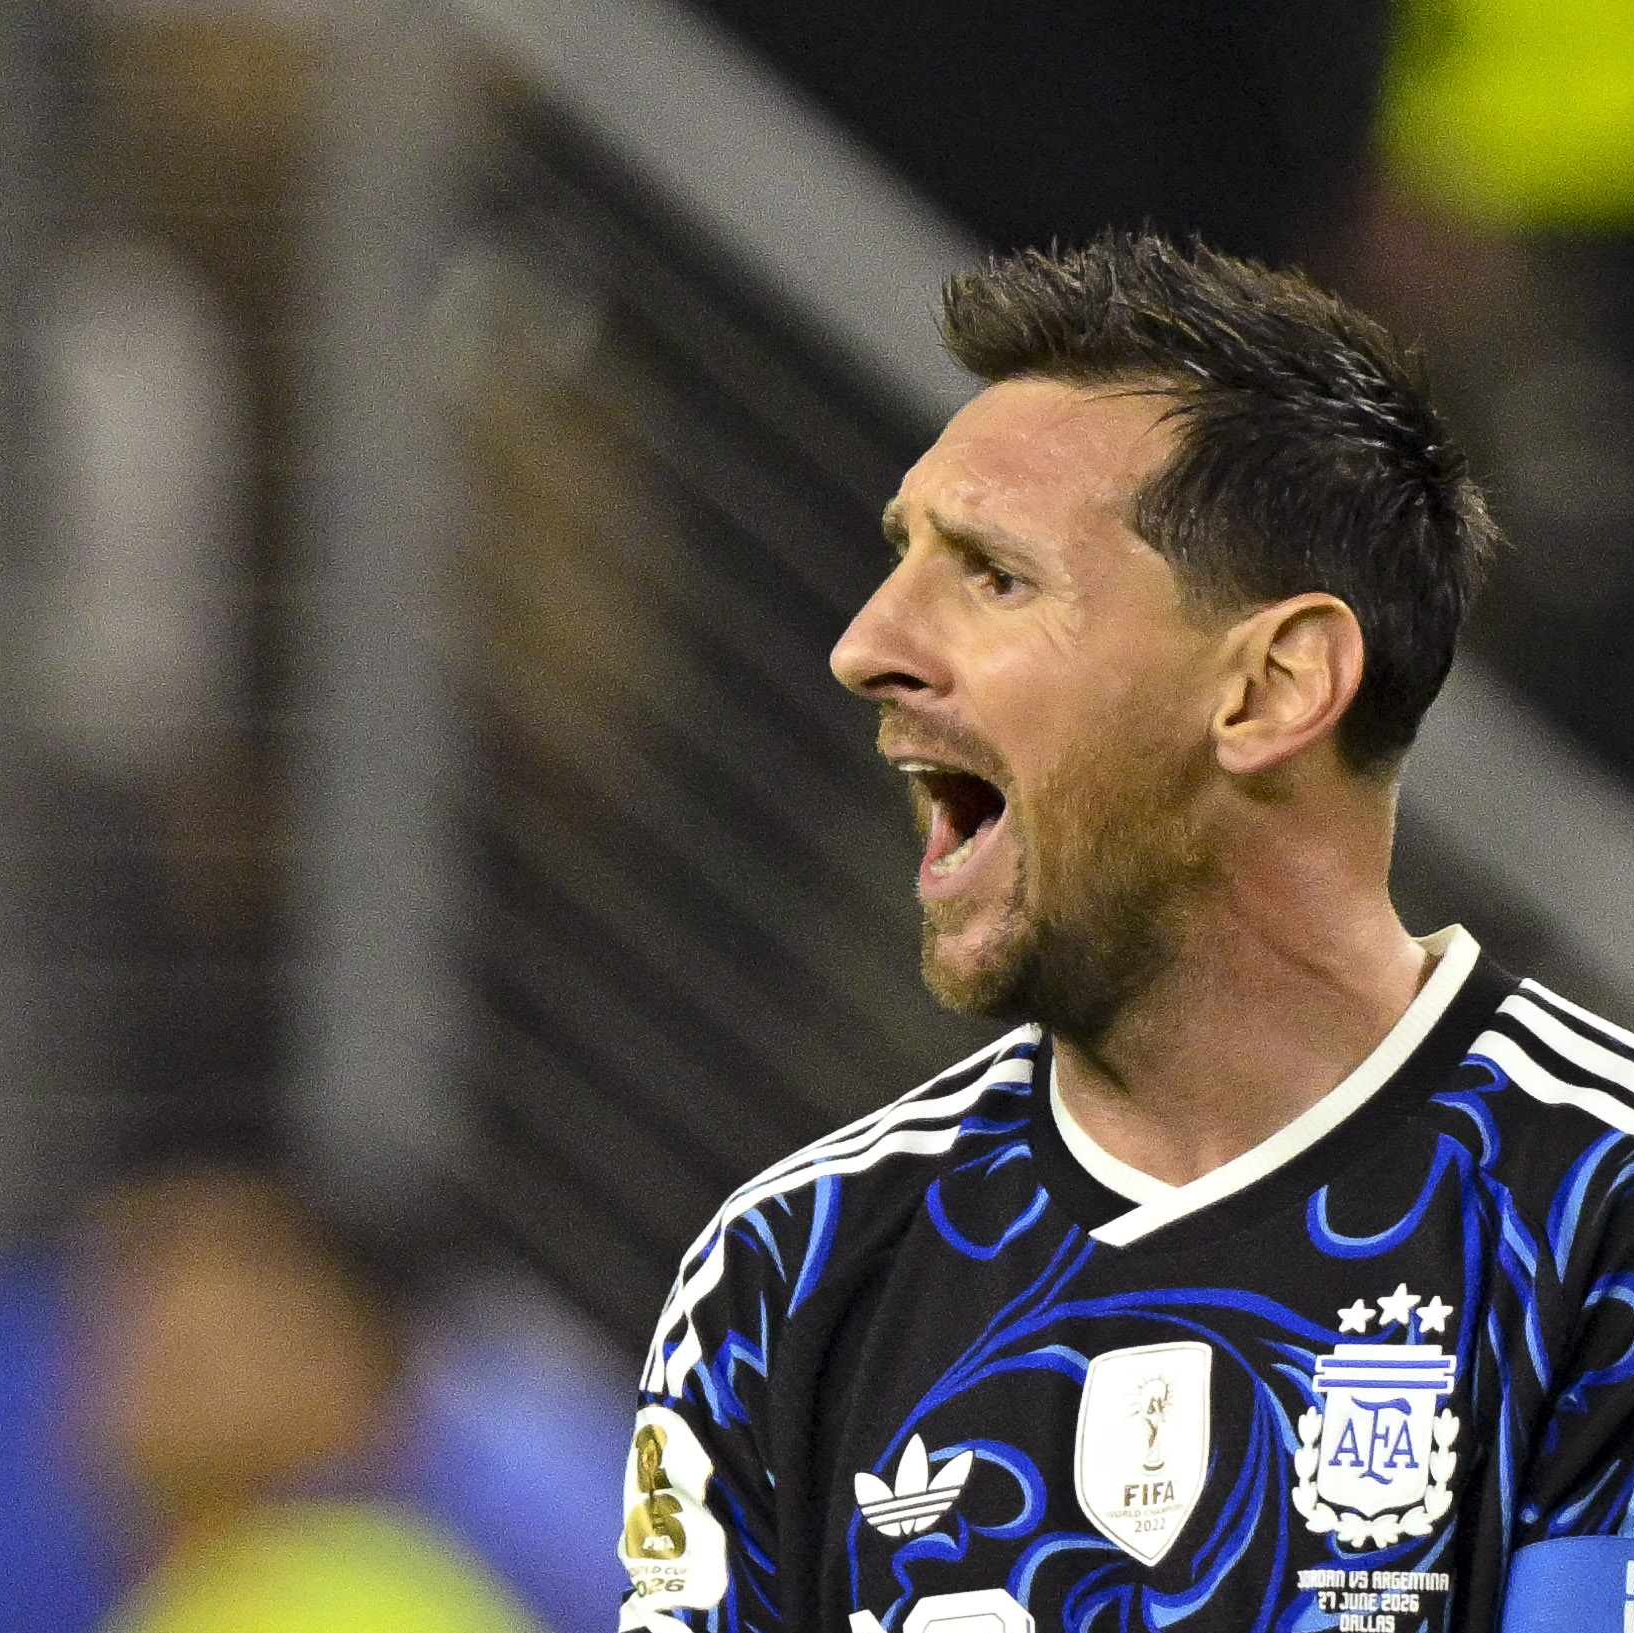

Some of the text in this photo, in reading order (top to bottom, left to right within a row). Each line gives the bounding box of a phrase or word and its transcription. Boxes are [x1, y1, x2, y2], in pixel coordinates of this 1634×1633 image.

[1328, 1395, 1419, 1485] AFA
[1124, 1480, 1174, 1507] FIFA
[1134, 1517, 1166, 1532] 2022
[629, 1565, 662, 1578] OLD
[1348, 1570, 1368, 1589] VS
[1372, 1570, 1450, 1591] ARGENTINA
[635, 1577, 686, 1598] 026
[1318, 1591, 1420, 1613] 27 JUNE 2026
[1339, 1614, 1395, 1633] DALLAS
